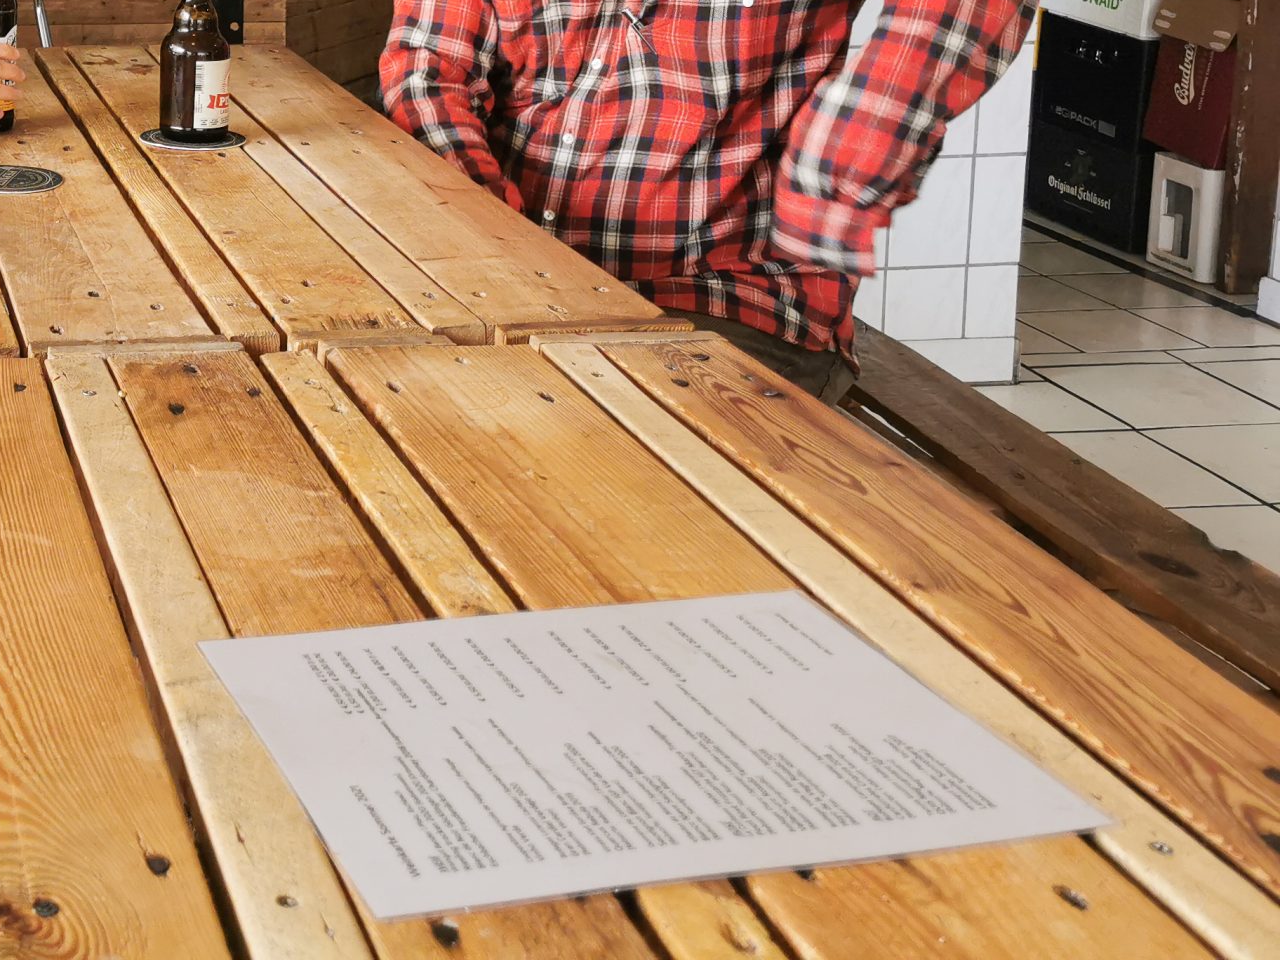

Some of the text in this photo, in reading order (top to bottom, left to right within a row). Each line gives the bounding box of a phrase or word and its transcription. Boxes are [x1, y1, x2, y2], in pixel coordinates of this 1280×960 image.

[1048, 175, 1111, 210] Original Schlüssel
[360, 803, 392, 834] Sommer
[383, 836, 423, 877] Weinkarte
